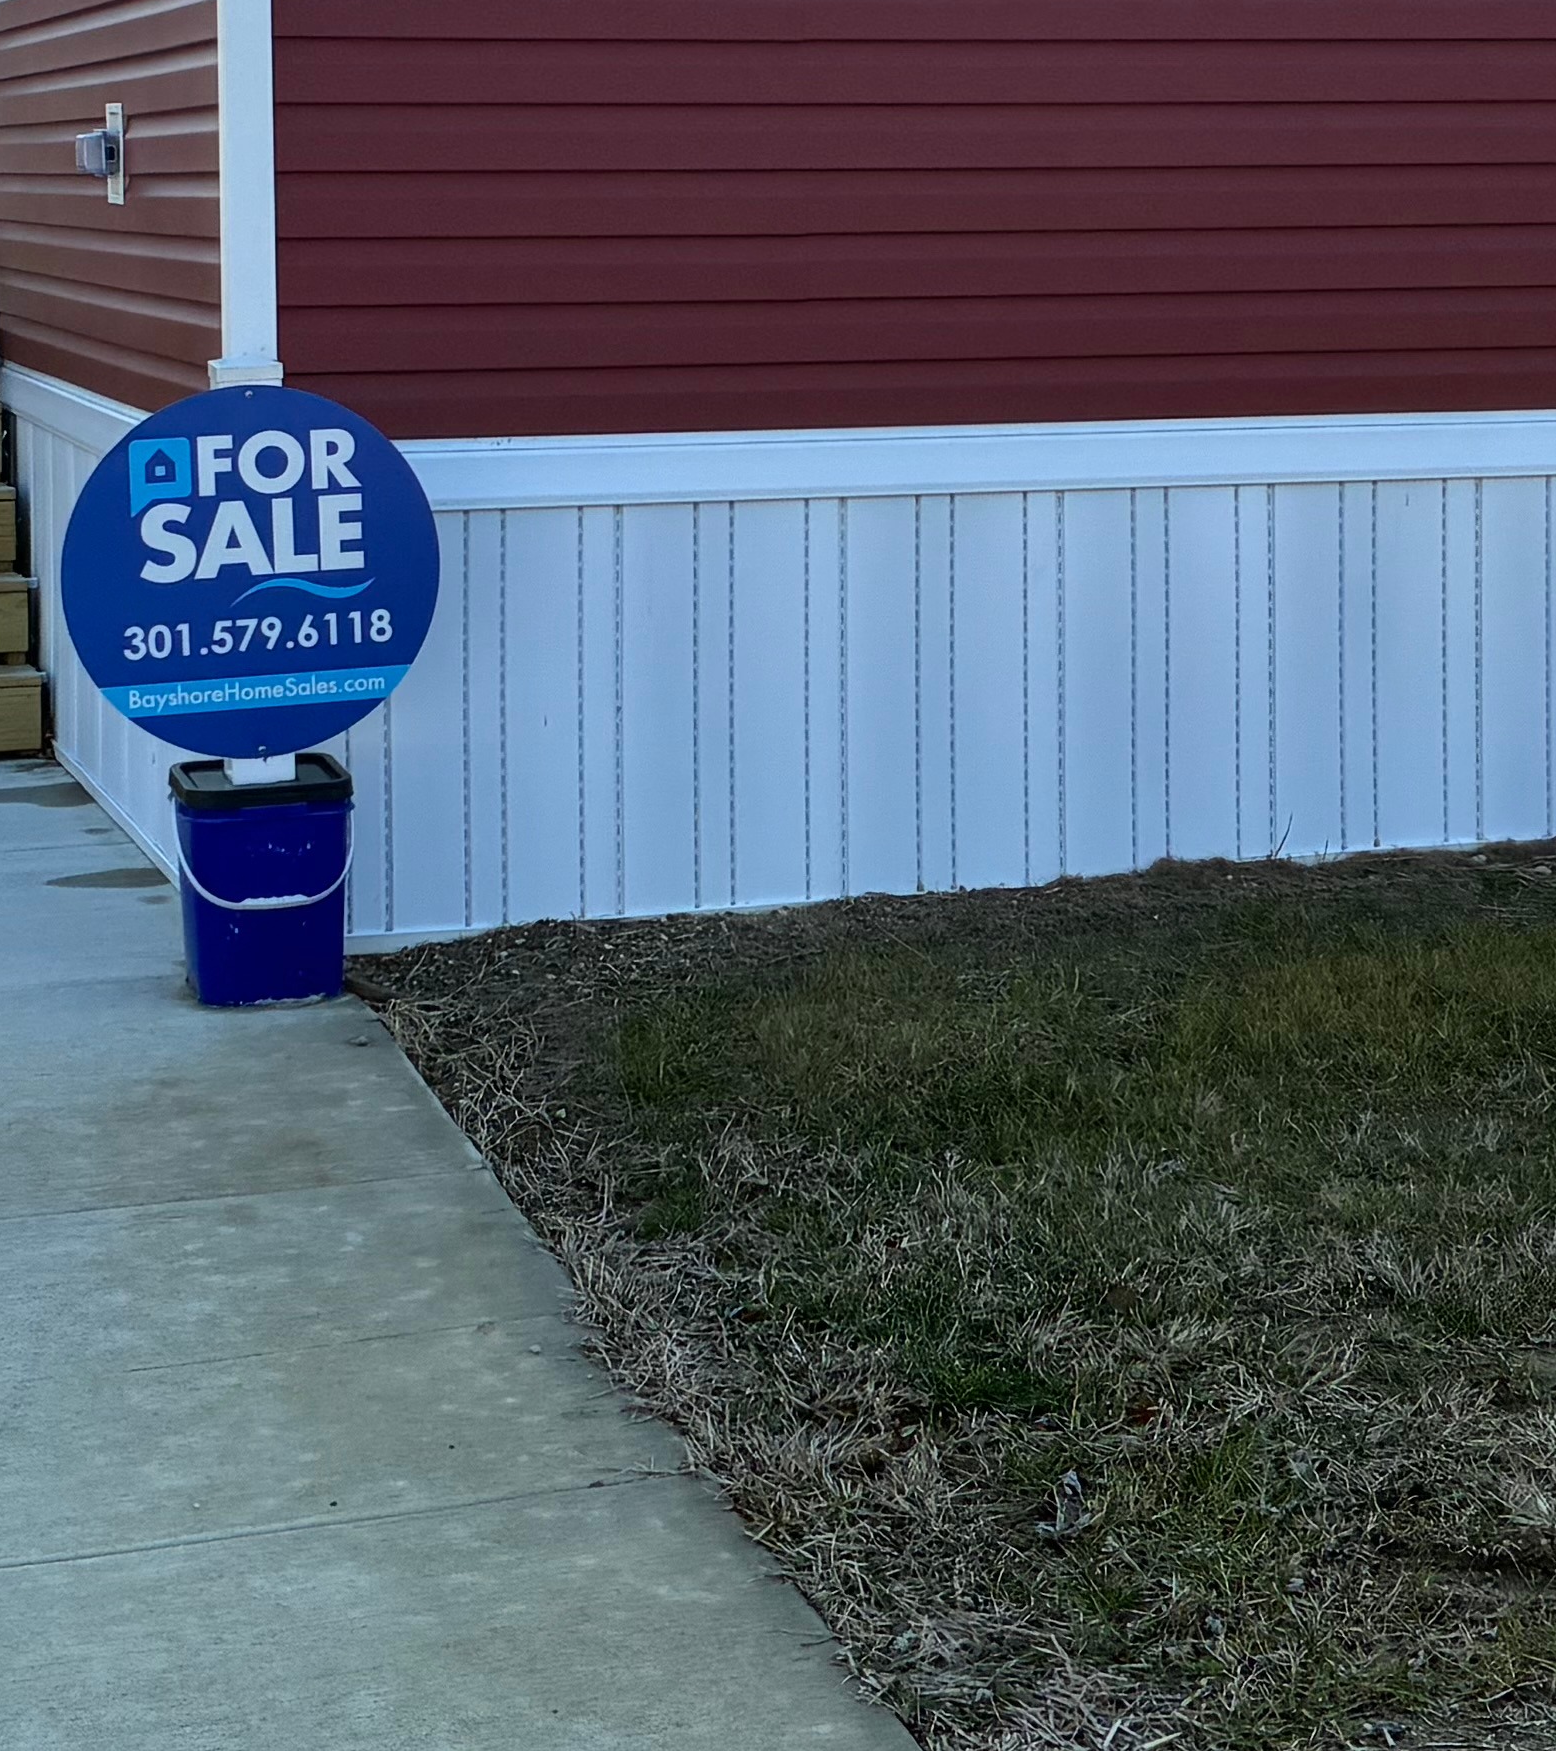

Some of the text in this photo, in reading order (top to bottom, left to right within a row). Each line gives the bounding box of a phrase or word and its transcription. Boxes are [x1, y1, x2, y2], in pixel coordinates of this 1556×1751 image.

[196, 428, 362, 497] FOR
[140, 493, 365, 584] SALE
[123, 608, 393, 661] 301.579.6118
[129, 675, 385, 713] BayshoreHomeSales.com
